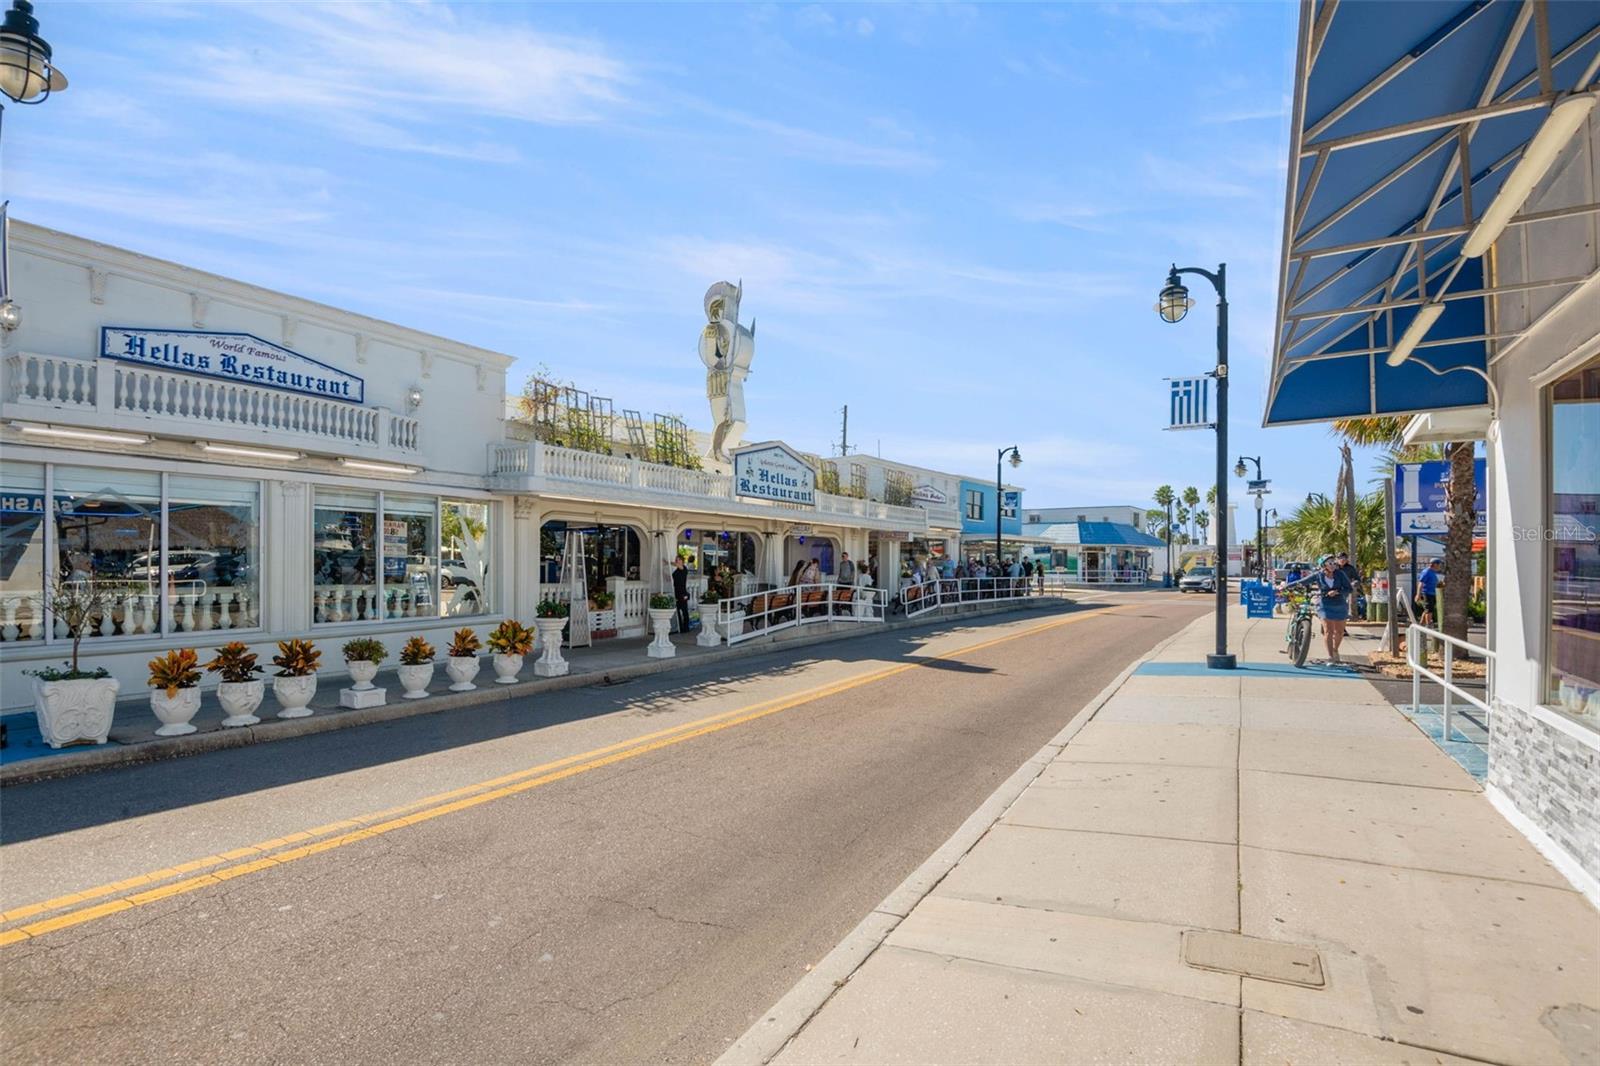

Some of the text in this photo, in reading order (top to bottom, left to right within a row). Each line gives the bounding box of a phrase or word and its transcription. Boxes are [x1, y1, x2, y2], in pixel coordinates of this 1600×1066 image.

[209, 339, 287, 363] World Famous
[123, 334, 351, 396] Hellas Restaurant
[757, 468, 798, 487] Hellas
[740, 478, 812, 502] Restaurant
